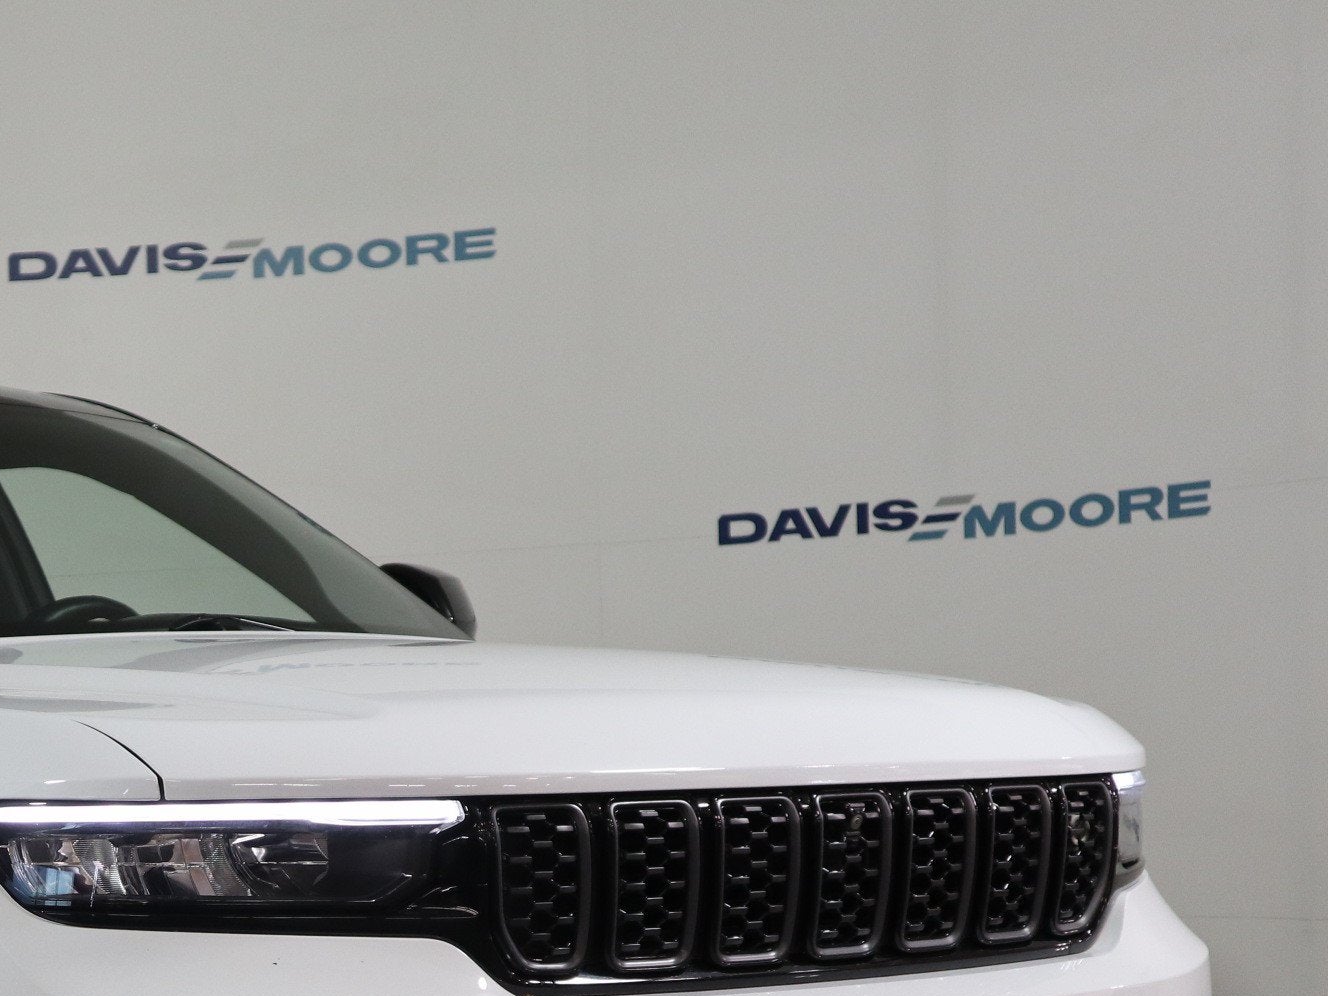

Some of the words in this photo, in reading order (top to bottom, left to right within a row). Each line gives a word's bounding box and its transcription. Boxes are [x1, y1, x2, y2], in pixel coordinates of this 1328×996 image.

[8, 241, 209, 282] DAVIS
[252, 227, 497, 279] MOORE
[718, 499, 919, 545] DAVIS
[964, 480, 1212, 539] MOORE
